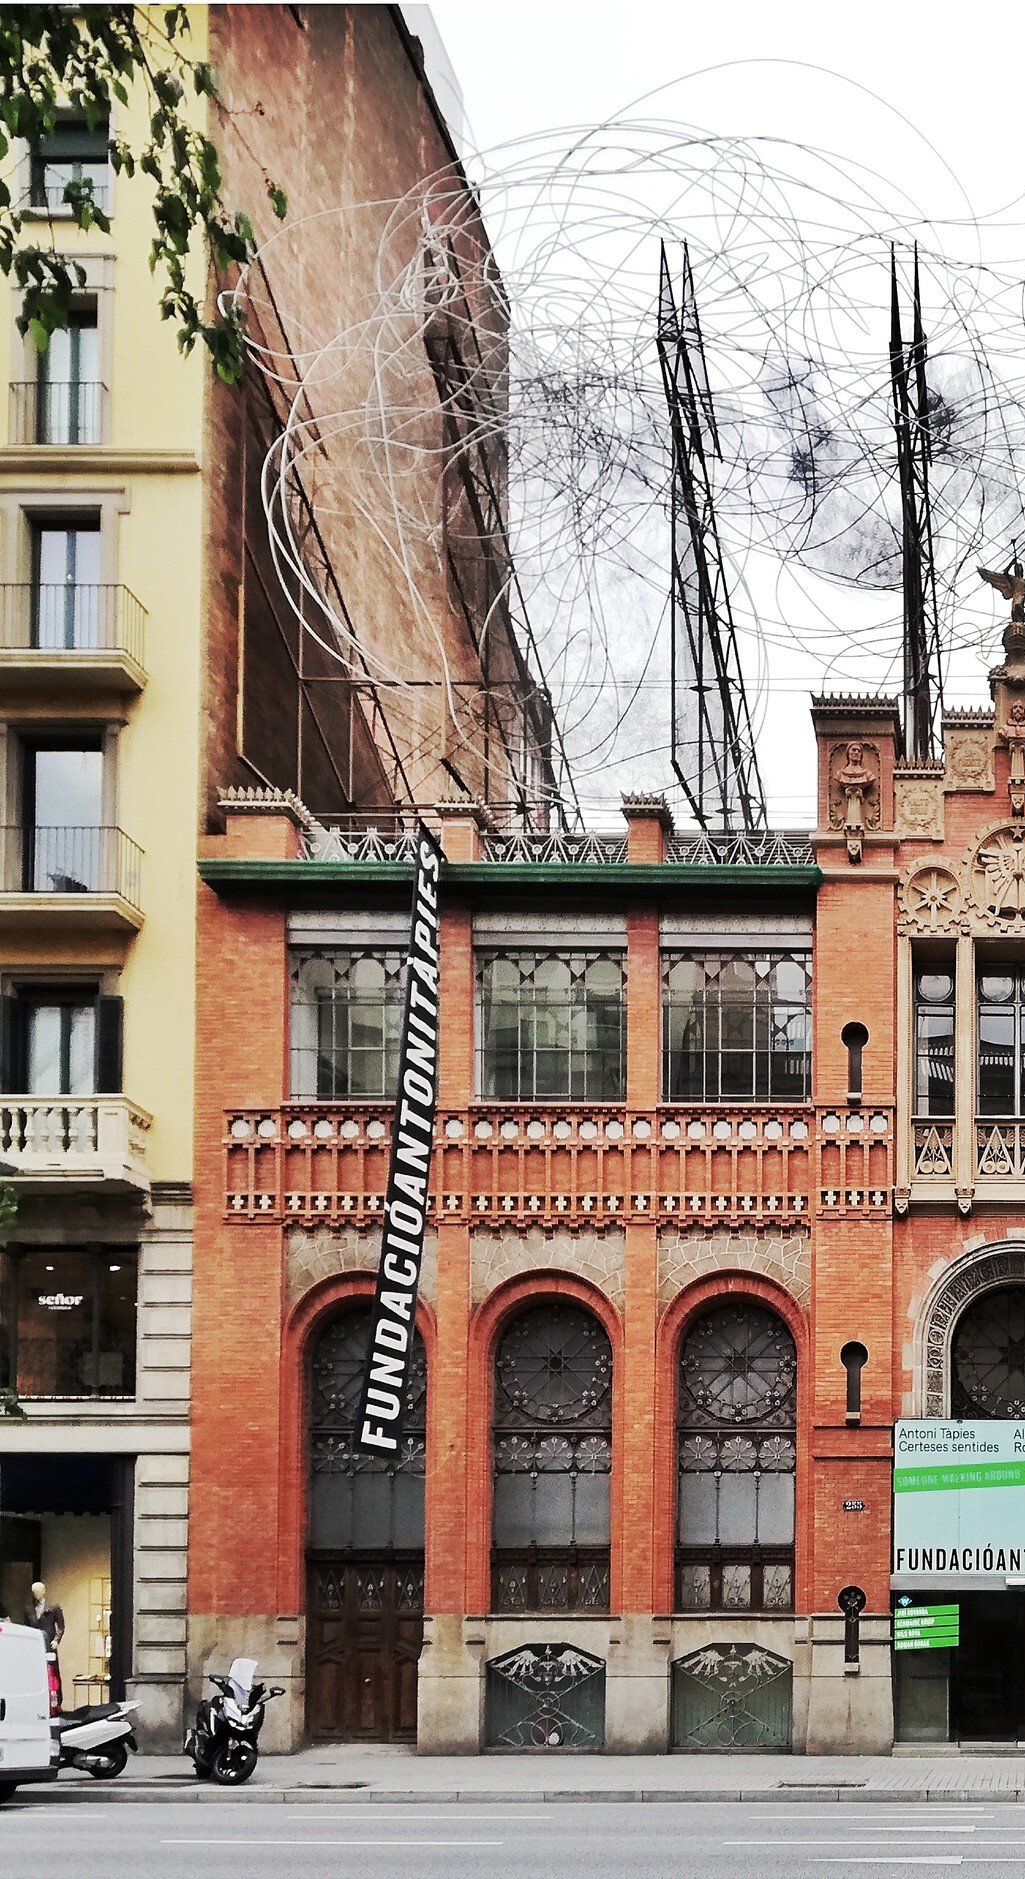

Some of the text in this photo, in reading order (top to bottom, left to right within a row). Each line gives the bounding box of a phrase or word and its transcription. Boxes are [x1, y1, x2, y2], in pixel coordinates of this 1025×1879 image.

[360, 840, 439, 1450] FUNDACIÓANTONITÀPIES
[898, 1427, 976, 1442] Antoni Tàpies
[898, 1441, 1000, 1453] Certeses sentides
[897, 1474, 938, 1487] SOMEONE
[942, 1471, 982, 1484] WALKING
[984, 1468, 1020, 1481] AROUND
[845, 1501, 863, 1510] 255
